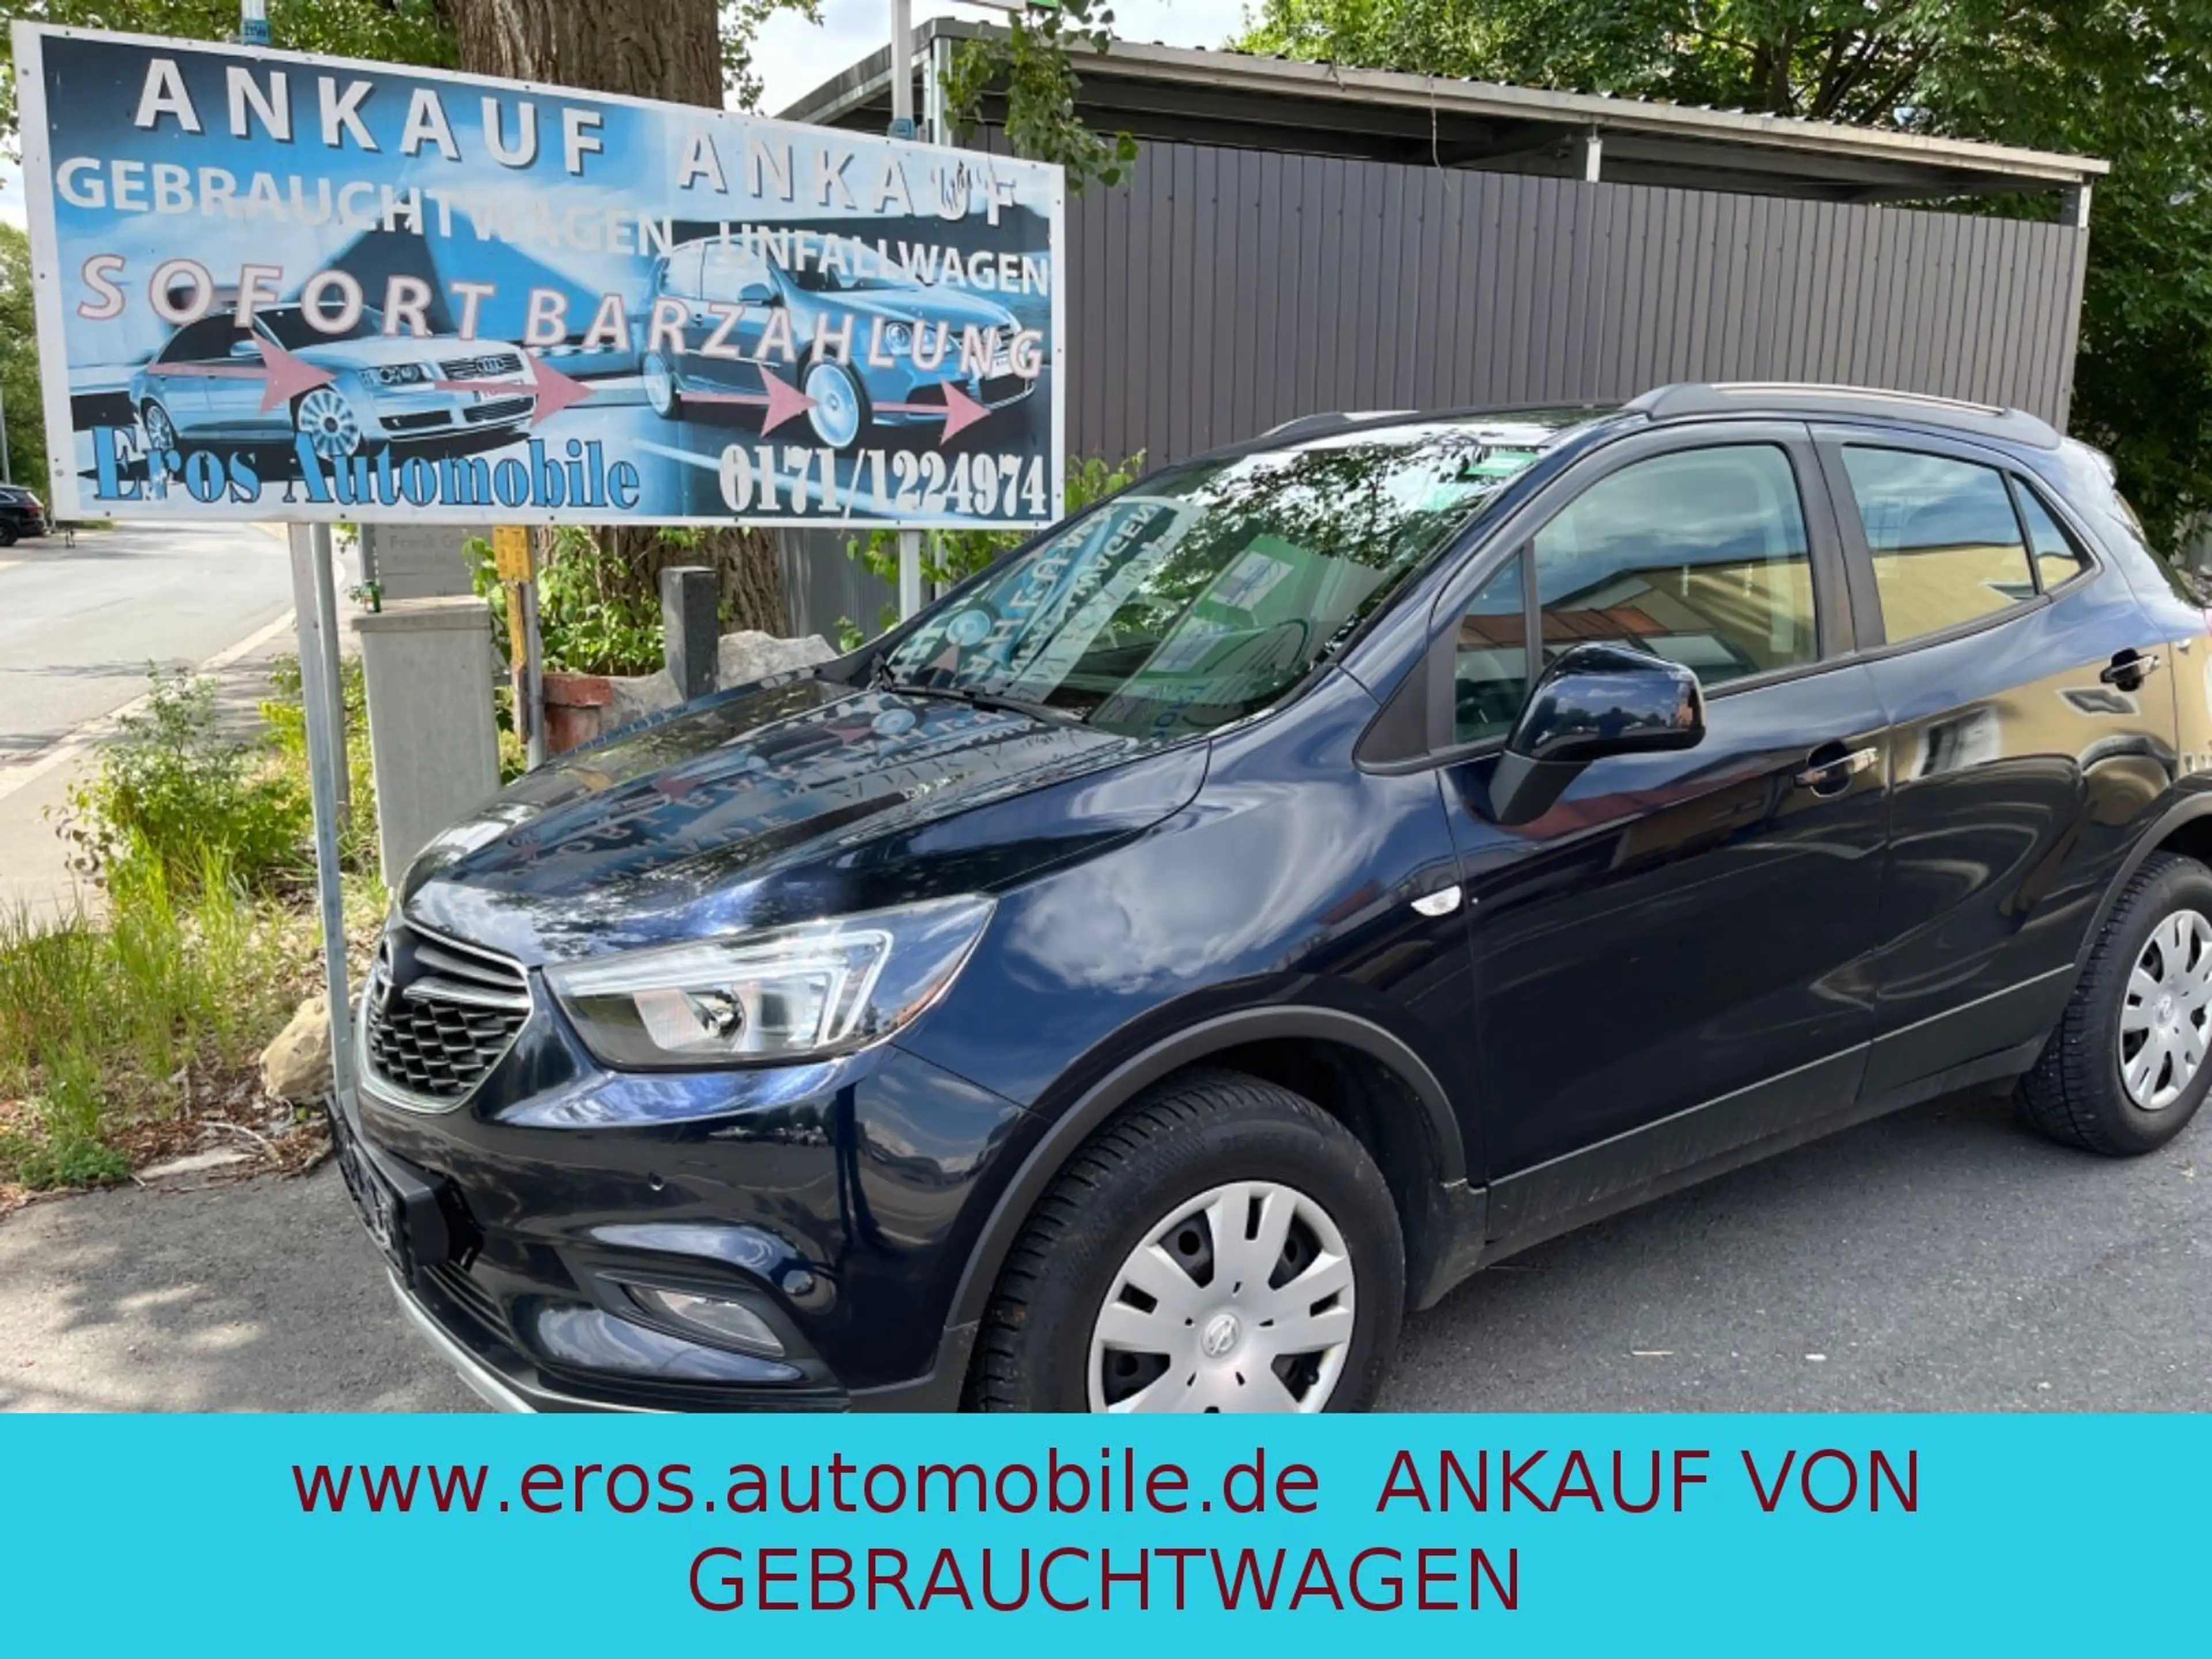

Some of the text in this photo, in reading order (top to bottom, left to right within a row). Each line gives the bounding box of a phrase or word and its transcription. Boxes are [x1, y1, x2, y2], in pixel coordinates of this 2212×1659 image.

[134, 58, 1017, 226] ANKAUF ANKAUF
[56, 157, 1050, 297] GEBRAUCHTWAGEN UNFALLWAGEN
[77, 253, 1045, 378] SOFORT BARZAHLUNG
[92, 425, 1047, 518] Eros Automobile 0171/1224974
